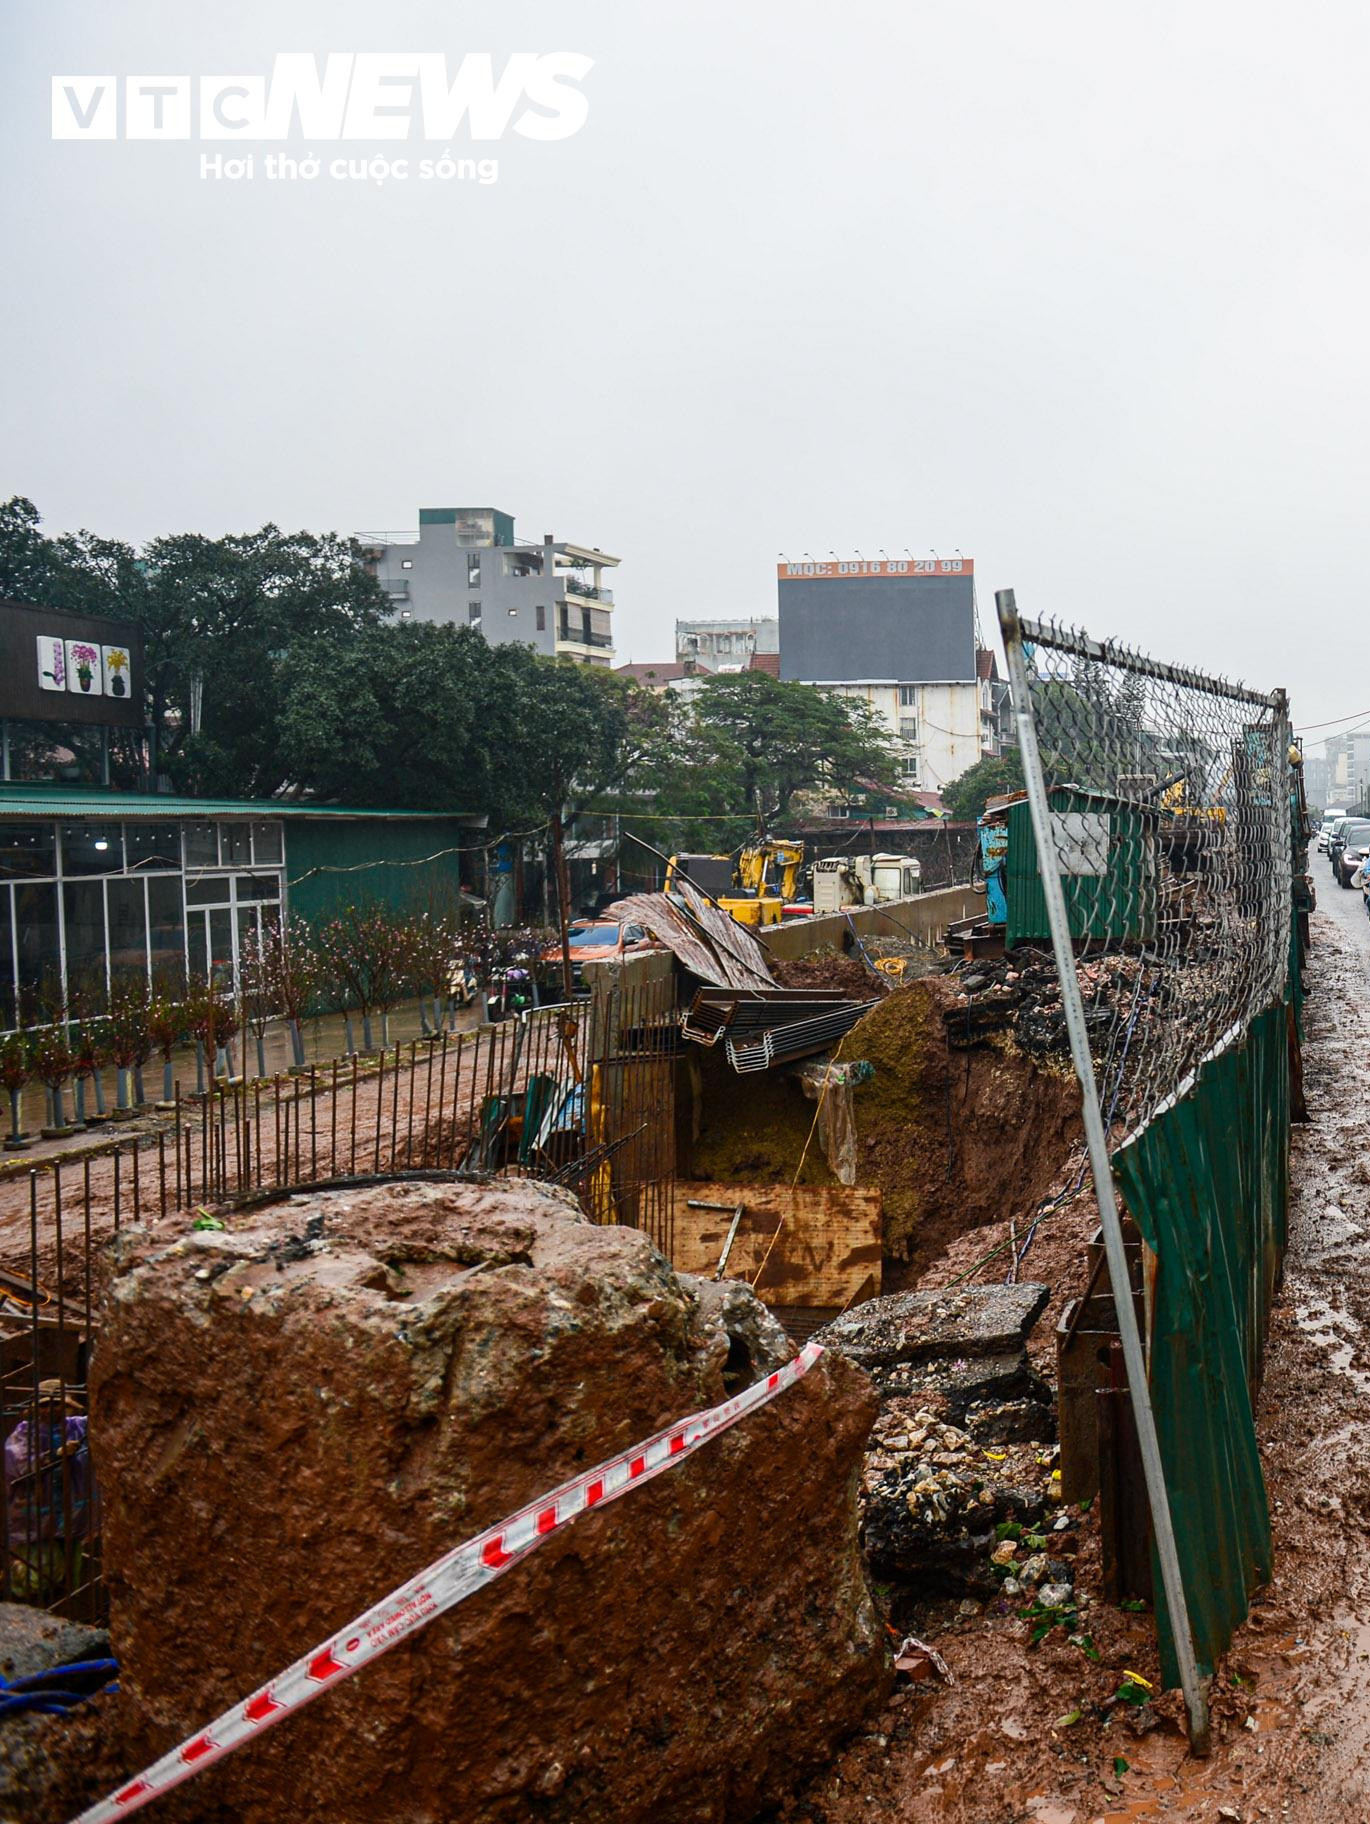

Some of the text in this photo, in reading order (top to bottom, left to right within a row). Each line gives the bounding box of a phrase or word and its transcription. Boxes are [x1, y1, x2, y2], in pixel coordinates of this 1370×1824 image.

[838, 561, 881, 574] 0916
[887, 561, 908, 573] 80
[914, 560, 935, 573] 20
[941, 560, 963, 572] 99
